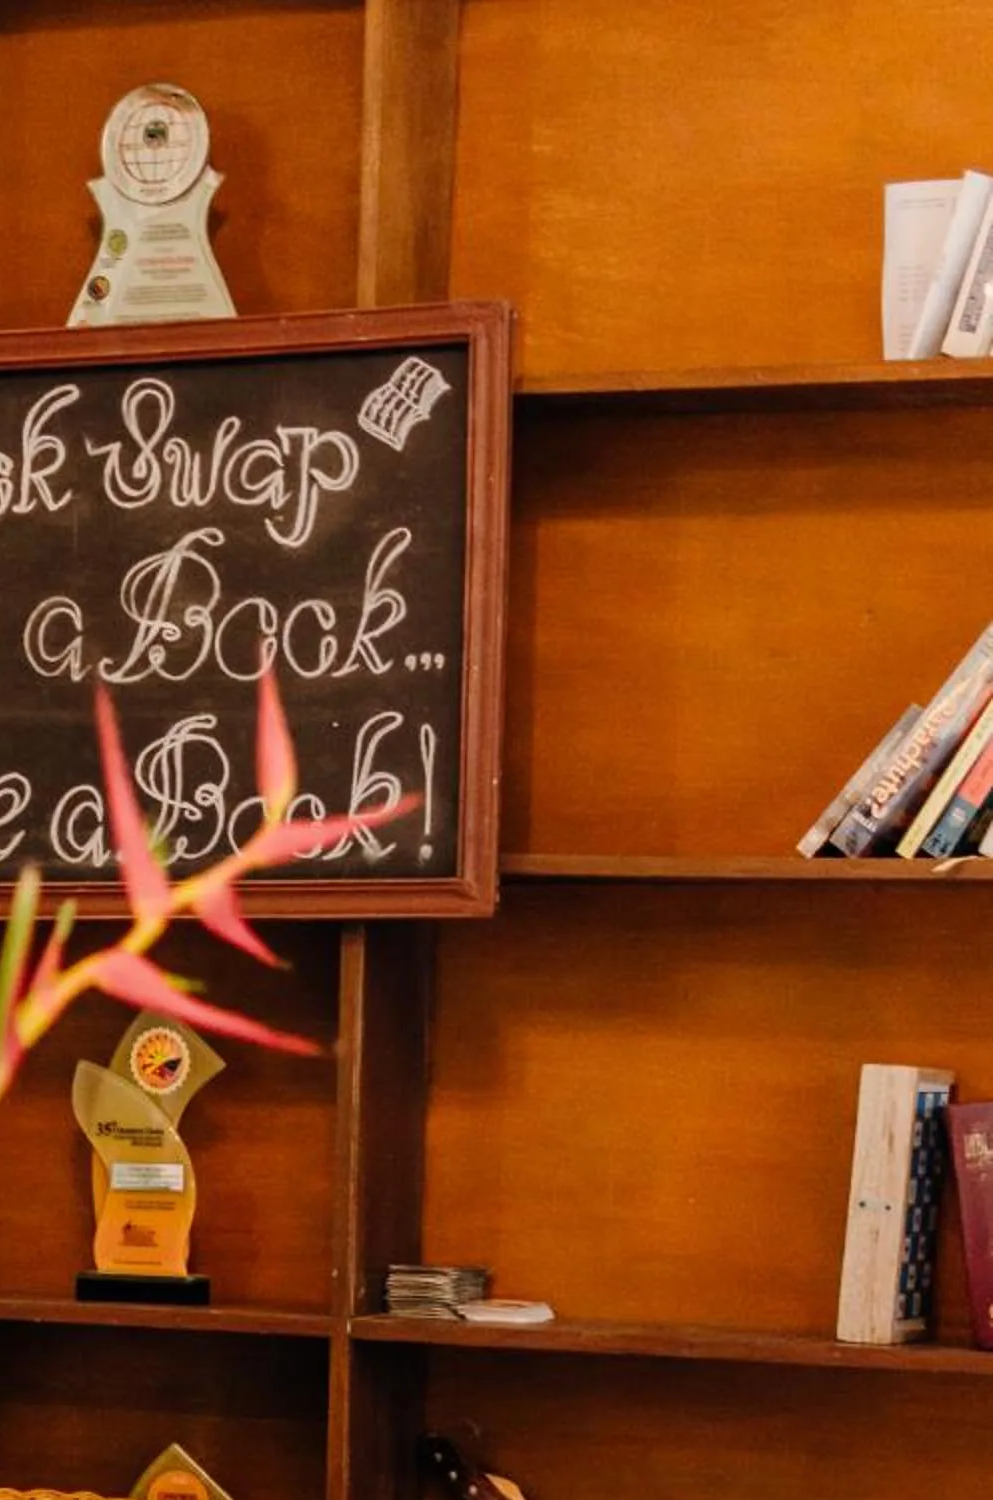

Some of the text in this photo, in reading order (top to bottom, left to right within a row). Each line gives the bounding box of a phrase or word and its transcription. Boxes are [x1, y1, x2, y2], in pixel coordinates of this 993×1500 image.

[84, 377, 361, 548] Swap
[23, 595, 93, 682] a
[50, 783, 110, 868] a
